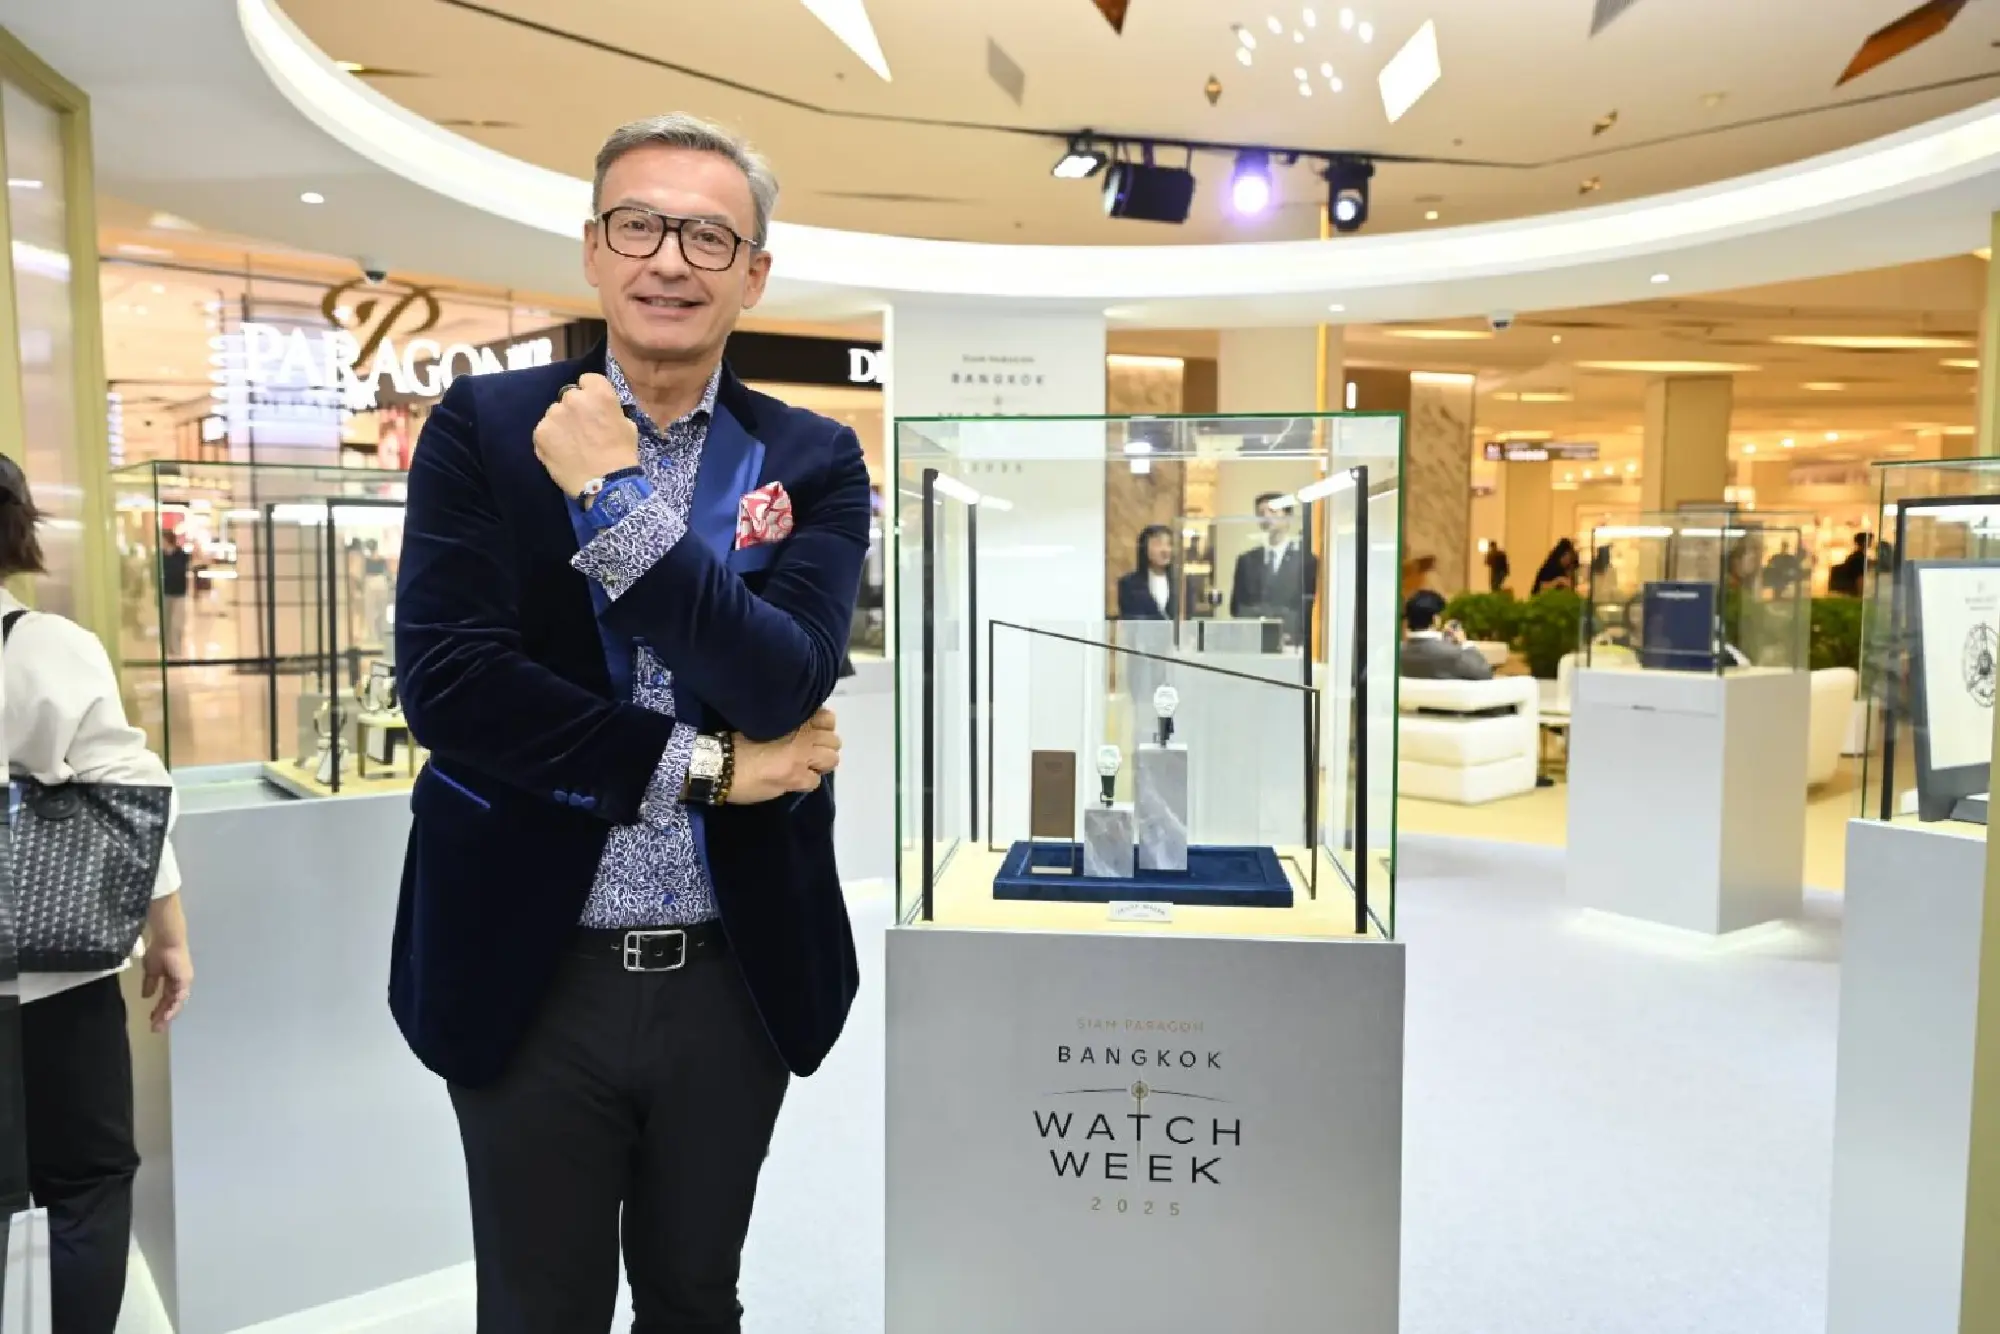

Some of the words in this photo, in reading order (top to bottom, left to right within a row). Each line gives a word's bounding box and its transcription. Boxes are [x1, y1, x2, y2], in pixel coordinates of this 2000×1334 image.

[1076, 1017, 1117, 1031] SIAM
[1125, 1018, 1204, 1034] PARAGON
[1057, 1045, 1222, 1069] BANGKOK
[1033, 1110, 1241, 1146] WATCH
[1050, 1149, 1222, 1185] WEEK
[1091, 1196, 1181, 1216] 2025
